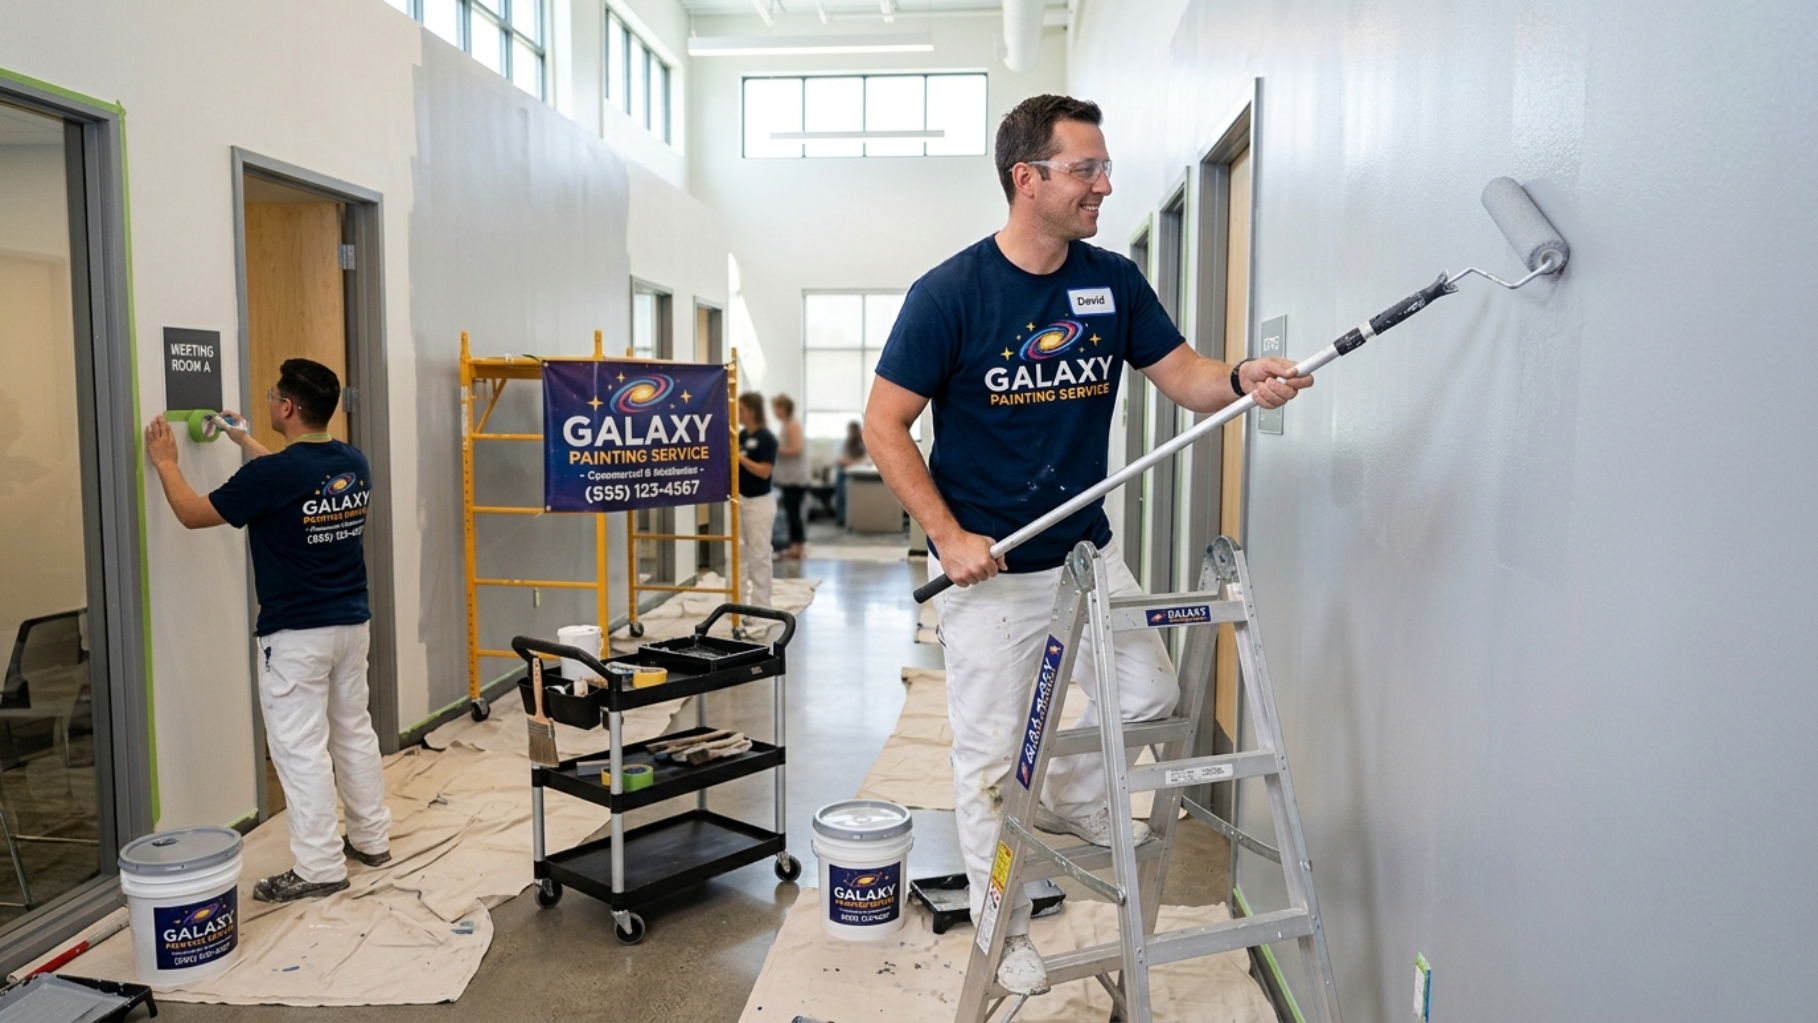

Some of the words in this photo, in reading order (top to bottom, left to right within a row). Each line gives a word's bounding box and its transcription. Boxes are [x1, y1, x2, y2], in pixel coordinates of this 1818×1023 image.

[172, 359, 201, 372] ROOM
[203, 360, 211, 373] A
[984, 355, 1113, 392] GALAXY
[990, 390, 1056, 406] PAINTING
[1059, 383, 1110, 401] SERVICE
[562, 414, 713, 447] GALAXY
[569, 449, 647, 465] PAINTING
[651, 446, 709, 462] SERVICE
[634, 479, 700, 498] 123-4567
[302, 490, 370, 515] GALAXY
